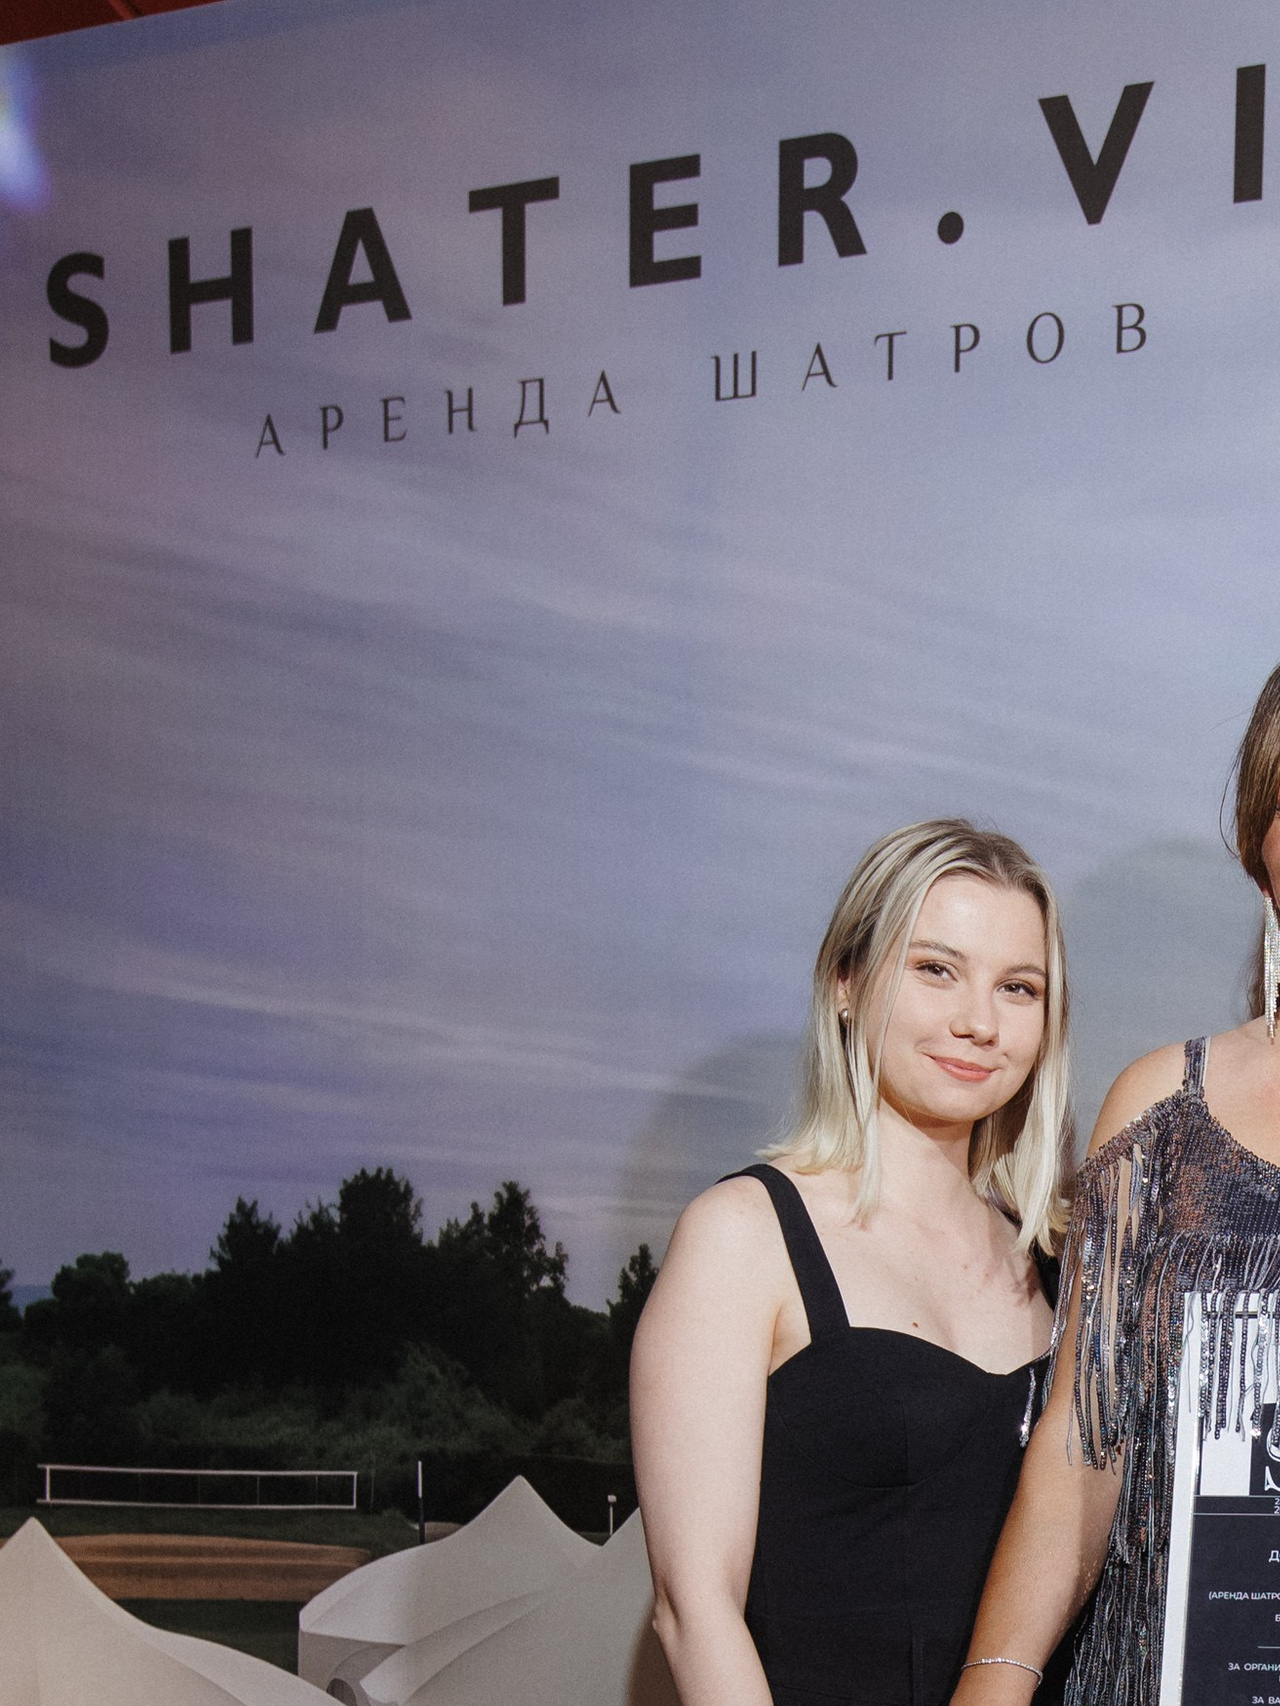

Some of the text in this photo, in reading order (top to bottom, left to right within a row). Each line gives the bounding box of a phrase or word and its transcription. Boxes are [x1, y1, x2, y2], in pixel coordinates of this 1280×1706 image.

[254, 302, 1148, 459] АРЕНДА ШАТРОВ
[1208, 1591, 1249, 1601] (АРЕНДА
[1228, 1663, 1240, 1671] ЗА
[1251, 1696, 1264, 1704] ЗА
